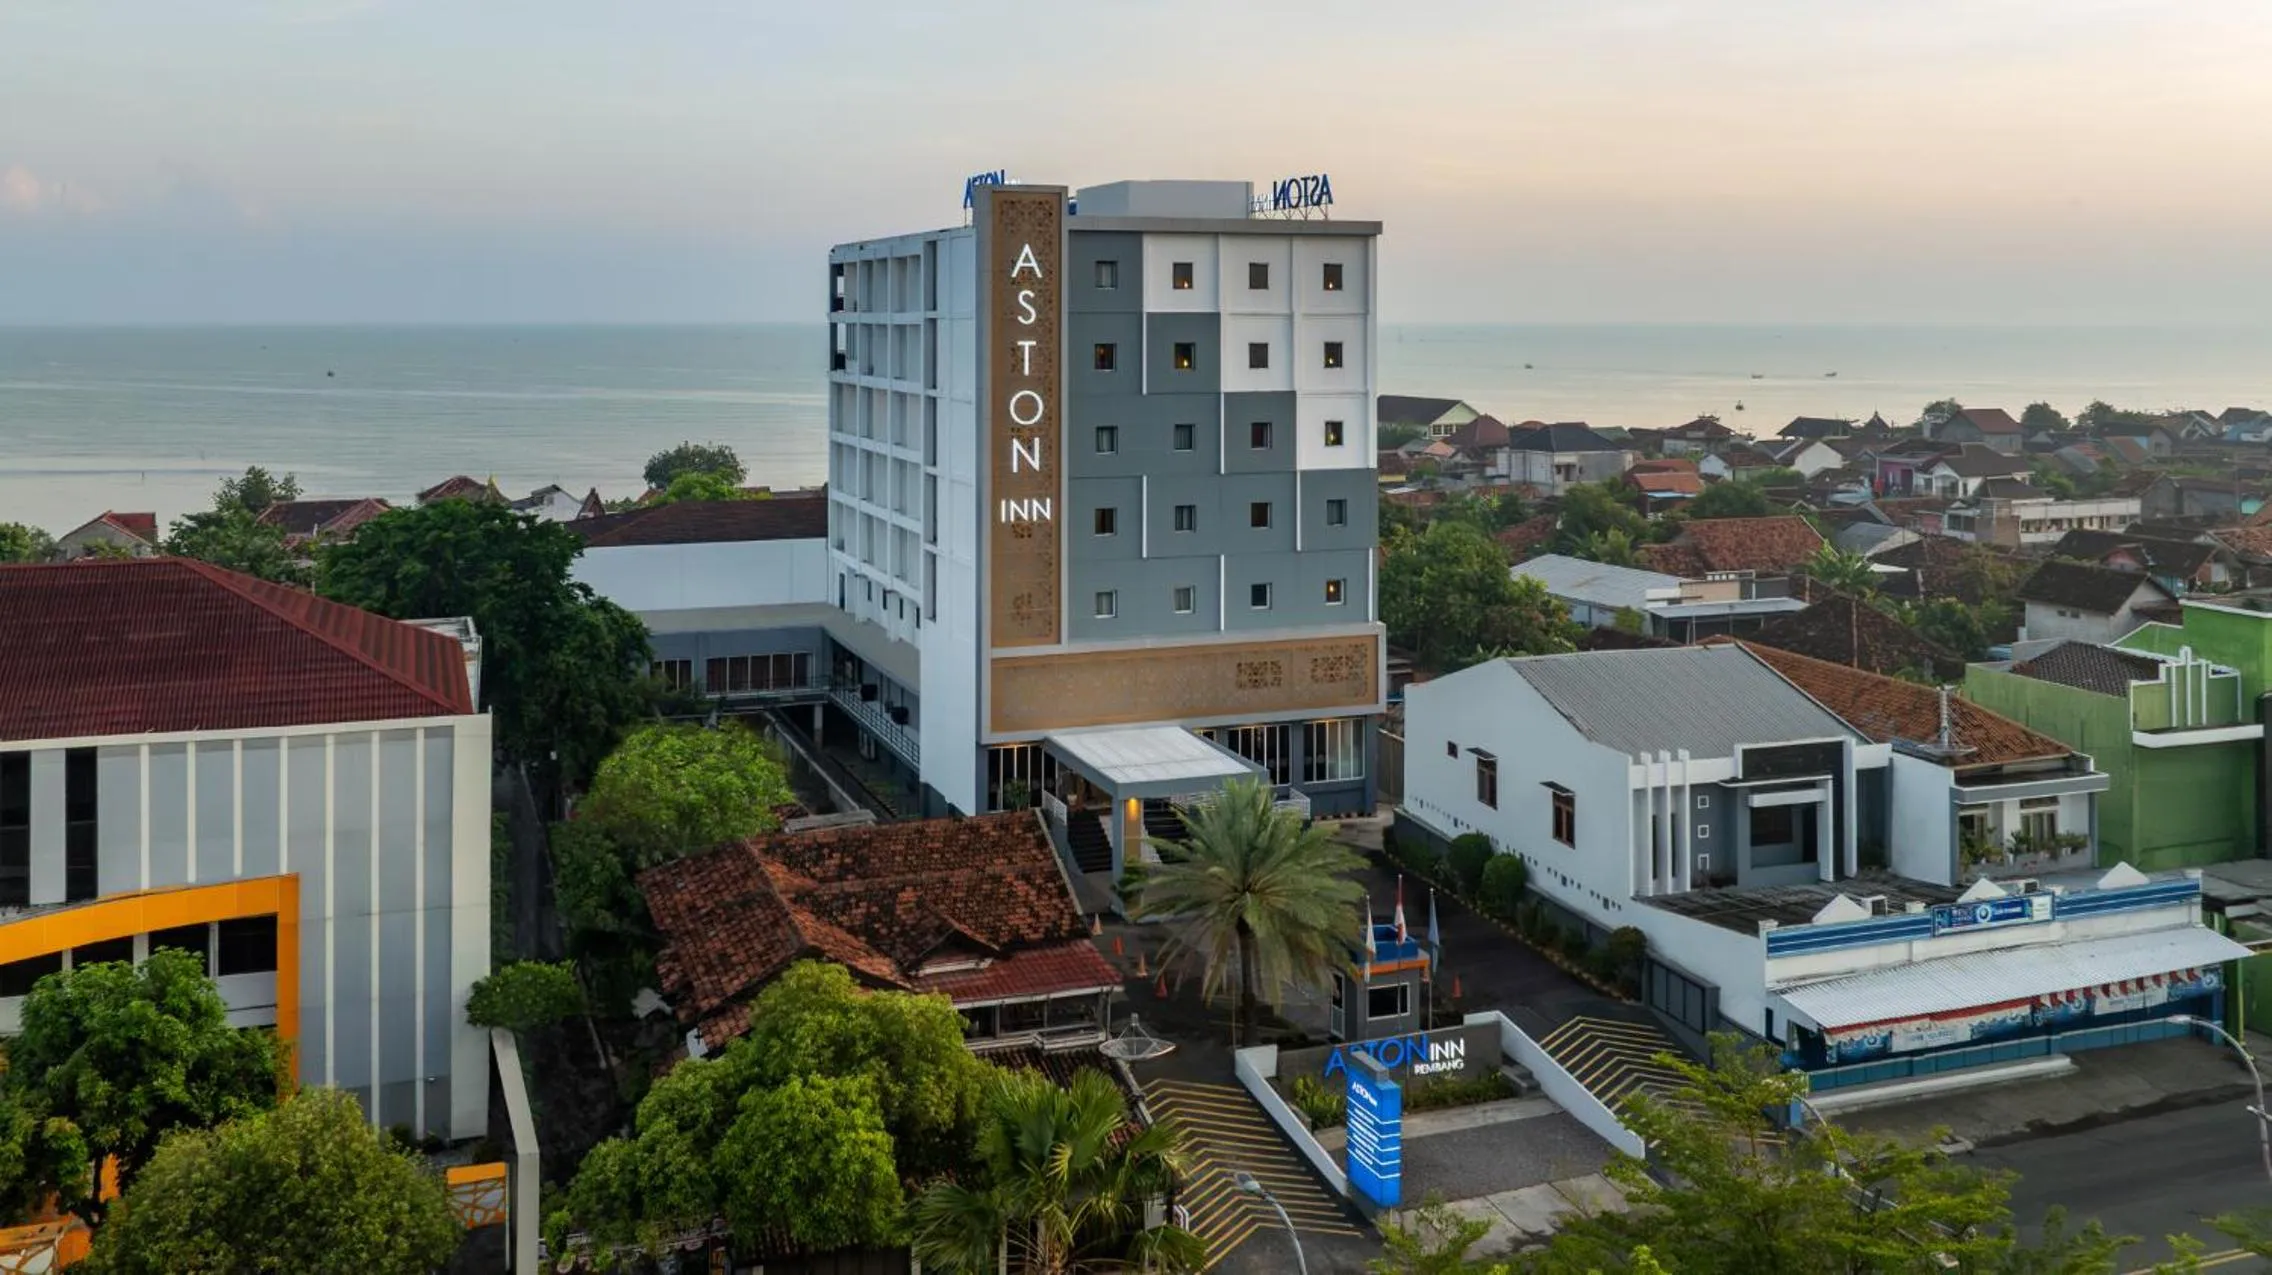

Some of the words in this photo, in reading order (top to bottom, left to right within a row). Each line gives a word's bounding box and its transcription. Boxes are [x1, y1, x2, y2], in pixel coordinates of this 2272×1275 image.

[1009, 243, 1044, 473] ASTON
[1001, 497, 1051, 523] INN
[1430, 1037, 1465, 1062] INN
[1413, 1058, 1465, 1076] REMBANG
